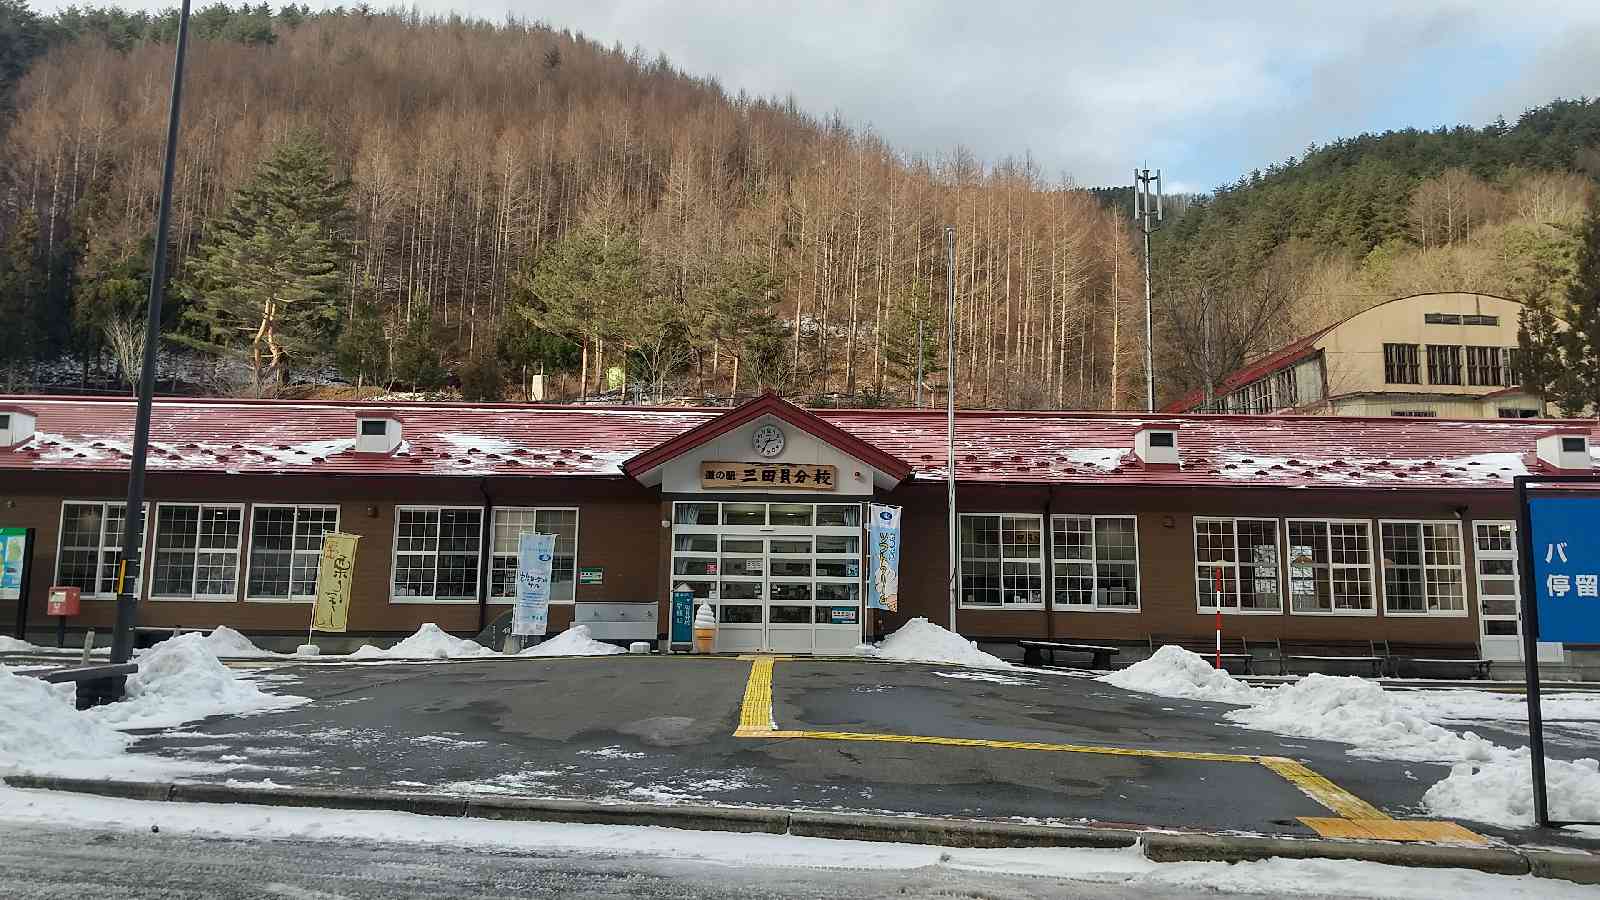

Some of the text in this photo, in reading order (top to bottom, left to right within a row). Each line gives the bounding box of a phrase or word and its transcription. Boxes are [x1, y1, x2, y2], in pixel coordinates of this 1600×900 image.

[740, 468, 833, 485] 三田貝分校
[1545, 542, 1568, 563] バ
[1546, 574, 1599, 597] 停留
